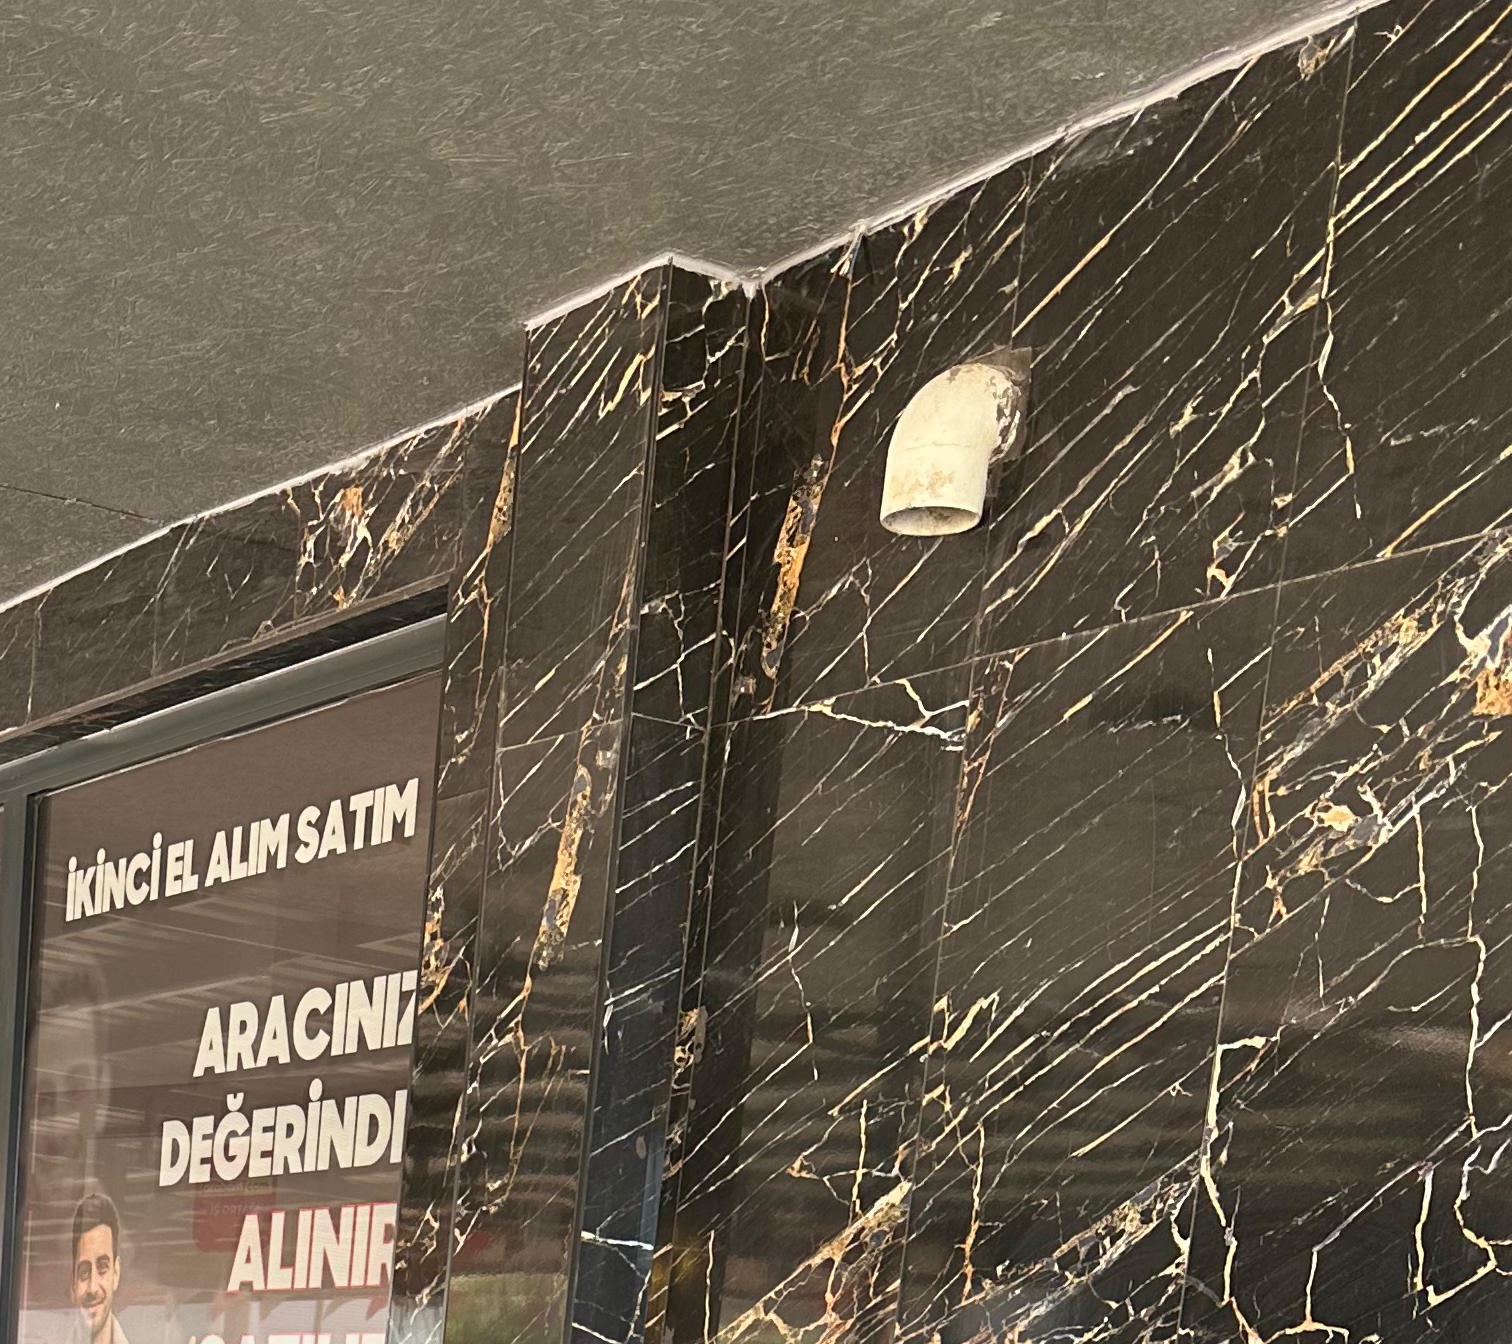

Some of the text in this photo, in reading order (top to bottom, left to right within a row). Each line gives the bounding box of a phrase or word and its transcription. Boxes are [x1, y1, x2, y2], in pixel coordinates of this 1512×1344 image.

[65, 777, 419, 922] İKİNCİ EL ALIM SATIM
